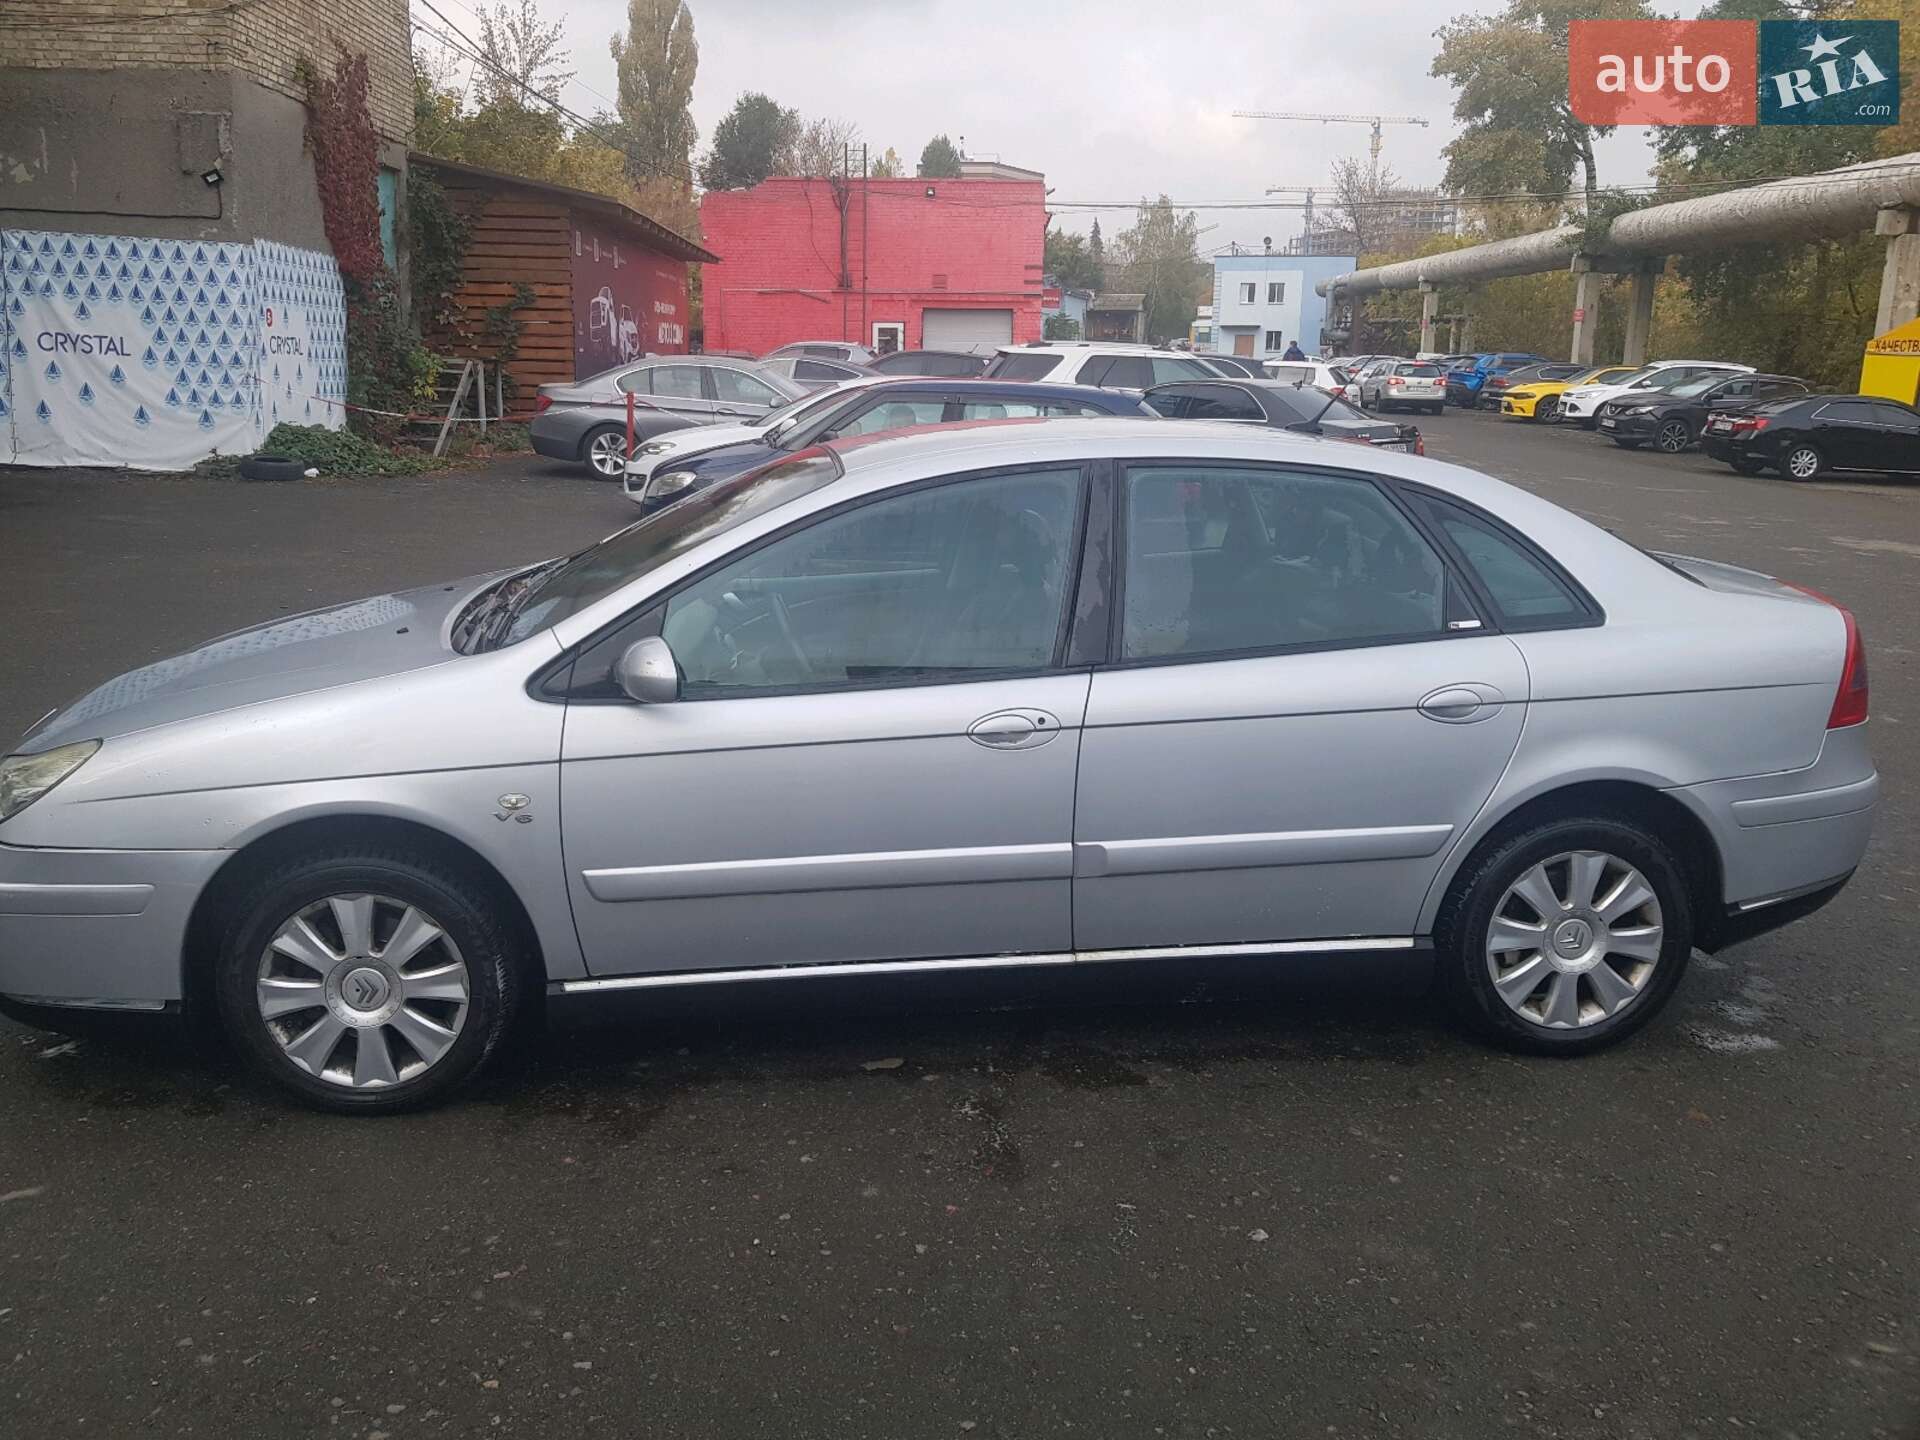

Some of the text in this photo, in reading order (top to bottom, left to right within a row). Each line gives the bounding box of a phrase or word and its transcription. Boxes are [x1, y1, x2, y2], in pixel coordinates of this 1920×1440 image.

[37, 331, 131, 357] CRYSTAL
[269, 336, 304, 356] CRYSTAL
[1876, 339, 1920, 353] КАЧЕСТВ
